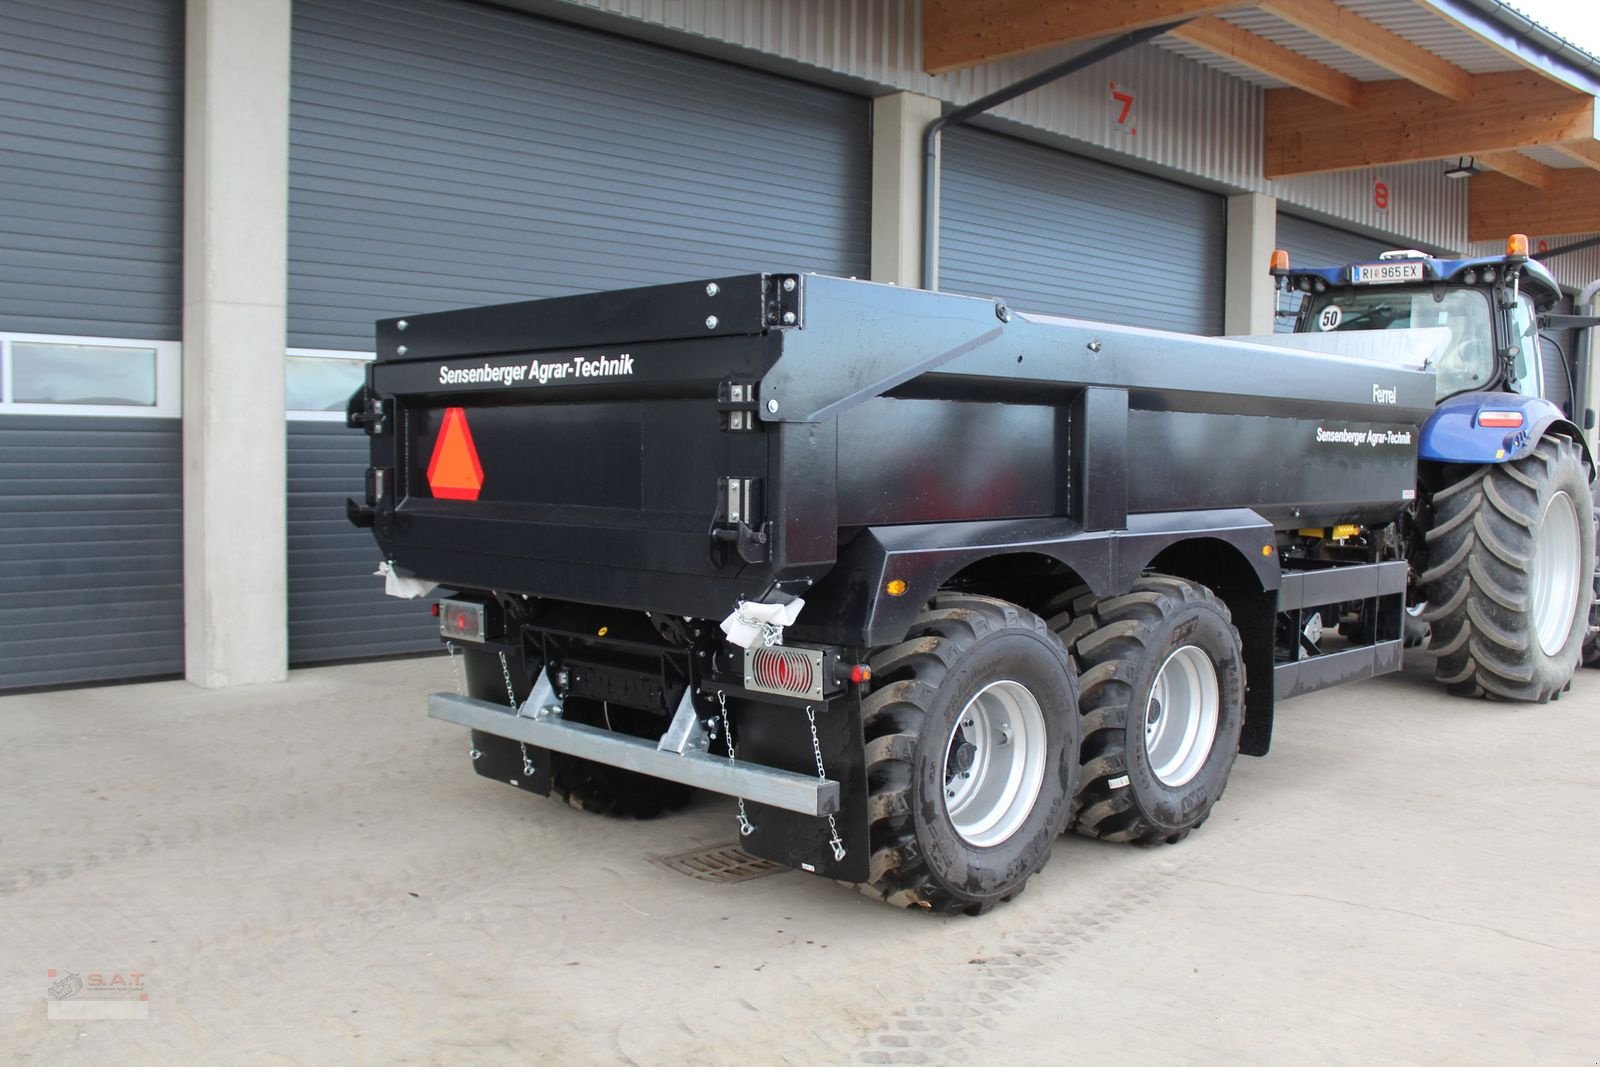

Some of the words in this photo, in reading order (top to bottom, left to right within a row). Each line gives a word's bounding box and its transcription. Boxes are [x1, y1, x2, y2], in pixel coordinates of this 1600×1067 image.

[1112, 91, 1134, 125] 7
[1375, 182, 1389, 209] 8
[1362, 268, 1373, 280] RI
[1322, 310, 1338, 327] 50
[439, 363, 527, 386] Sensenberger
[528, 353, 635, 384] Agrar-Technik
[1372, 383, 1397, 404] Ferrel
[1316, 426, 1366, 447] Sensenberger
[1366, 429, 1412, 447] Agrar-Technik
